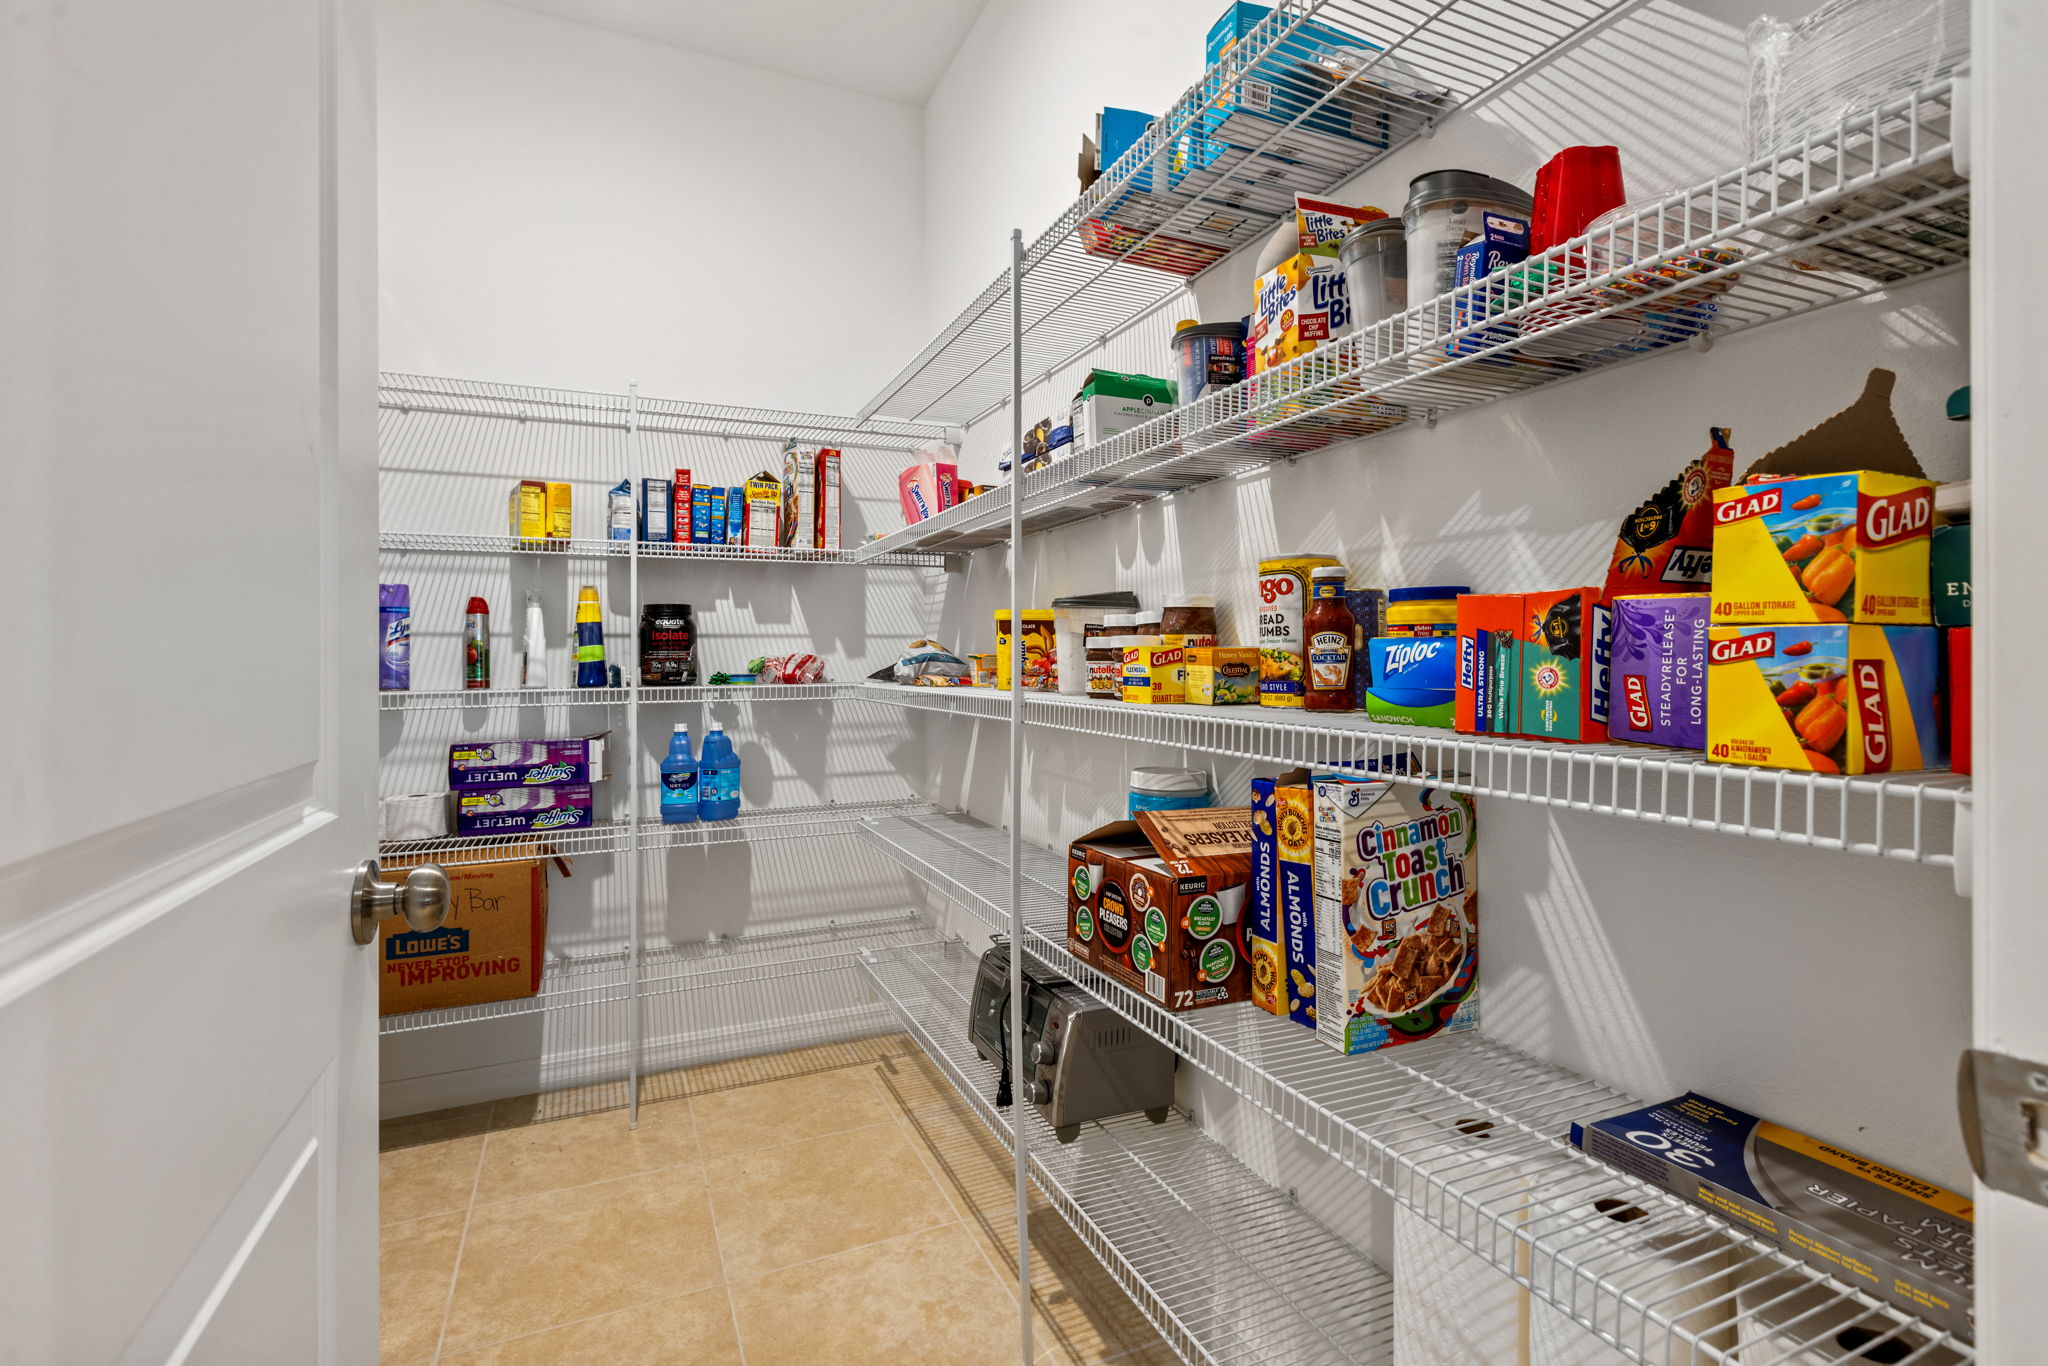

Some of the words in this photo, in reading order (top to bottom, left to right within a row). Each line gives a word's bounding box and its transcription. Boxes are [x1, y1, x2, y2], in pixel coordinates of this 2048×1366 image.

[1305, 214, 1333, 233] Little
[1316, 228, 1346, 243] Bites
[1463, 254, 1472, 277] Oven
[1260, 275, 1287, 316] Little
[1268, 285, 1297, 325] Bites
[1301, 316, 1327, 325] CHOCOLATE
[1303, 330, 1324, 338] MUFFINS
[750, 481, 764, 489] TWIN
[764, 482, 778, 490] PACK
[1716, 493, 1779, 523] GLAD
[1865, 496, 1930, 543] GLAD
[1714, 602, 1732, 616] 40
[1733, 601, 1761, 610] GALLON
[1762, 600, 1797, 610] STORAGE
[1861, 594, 1876, 616] 40
[1876, 596, 1897, 608] GALLON
[1897, 597, 1920, 609] STORAGE
[652, 630, 689, 640] Isolate
[655, 619, 685, 629] equate
[1317, 636, 1343, 645] HEINZ
[1712, 636, 1772, 661] GLAD
[1123, 650, 1139, 663] GLAD
[1152, 650, 1183, 666] GLAD
[1218, 651, 1238, 660] Honey
[1312, 653, 1347, 662] COCKTAIL
[1384, 641, 1441, 674] Ziploc
[1462, 640, 1474, 687] Hefty
[1594, 612, 1612, 720] Hefty
[1221, 665, 1250, 675] CELESTIAL
[1660, 610, 1675, 727] STEADYRELEASE
[1676, 657, 1688, 685] FOR
[1690, 618, 1705, 725] LONG-LASTING
[1152, 683, 1162, 691] 38
[1269, 683, 1288, 691] STYLE
[1152, 694, 1173, 703] QUART
[1629, 677, 1648, 727] GLAD
[1371, 714, 1414, 724] SANDWICH
[1859, 664, 1887, 764] GLAD
[1711, 743, 1729, 758] 40
[467, 772, 518, 782] WETJET
[525, 763, 576, 780] Swiffer
[474, 816, 526, 829] WETJET
[532, 808, 584, 825] Swiffer
[1278, 810, 1288, 831] HONEY
[1287, 808, 1308, 835] BUNCHES
[1183, 830, 1253, 846] PLEASERS
[1287, 838, 1305, 848] OATS
[1360, 809, 1461, 857] Cinnamon
[1174, 863, 1193, 874] 72
[1382, 837, 1447, 882] Toast
[1180, 881, 1206, 891] KEURIG
[1260, 841, 1271, 932] ALMONDS
[1370, 858, 1465, 917] Crunch
[464, 887, 506, 912] Bar
[1102, 897, 1125, 917] CROWD
[1099, 908, 1129, 931] PLEASERS
[1286, 870, 1305, 964] ALMONDS
[395, 934, 462, 956] LOWE'S
[387, 959, 435, 974] NEVER
[436, 956, 470, 968] STOP
[400, 957, 521, 987] IMPROVING
[1206, 956, 1229, 969] NANTUCKET
[1211, 962, 1225, 971] BLEND
[1174, 990, 1194, 1008] 72
[1625, 1131, 1716, 1169] 30
[1661, 1132, 1703, 1153] SHEETS
[1664, 1128, 1713, 1153] FEUILLES
[1818, 1145, 1869, 1168] BRAND
[1856, 1166, 1872, 1175] vs
[1871, 1164, 1940, 1195] LEADING
[1874, 1174, 1934, 1200] SHEETS
[1698, 1187, 1715, 1199] Wrap
[1715, 1195, 1728, 1205] and
[1728, 1201, 1741, 1211] seal
[1741, 1207, 1774, 1226] containers
[1698, 1192, 1714, 1205] Keep
[1714, 1199, 1729, 1211] food
[1729, 1208, 1748, 1220] warm
[1747, 1217, 1761, 1226] and
[1761, 1222, 1778, 1234] fresh
[1807, 1184, 1923, 1236] PAPIER
[1788, 1228, 1813, 1248] Protect
[1814, 1240, 1841, 1258] kitchen
[1841, 1255, 1873, 1274] surfaces
[1788, 1235, 1808, 1249] Wrap
[1808, 1246, 1841, 1265] potatoes
[1840, 1260, 1852, 1270] for
[1852, 1266, 1880, 1285] baking
[1894, 1278, 1912, 1291] Grill
[1912, 1288, 1929, 1300] and
